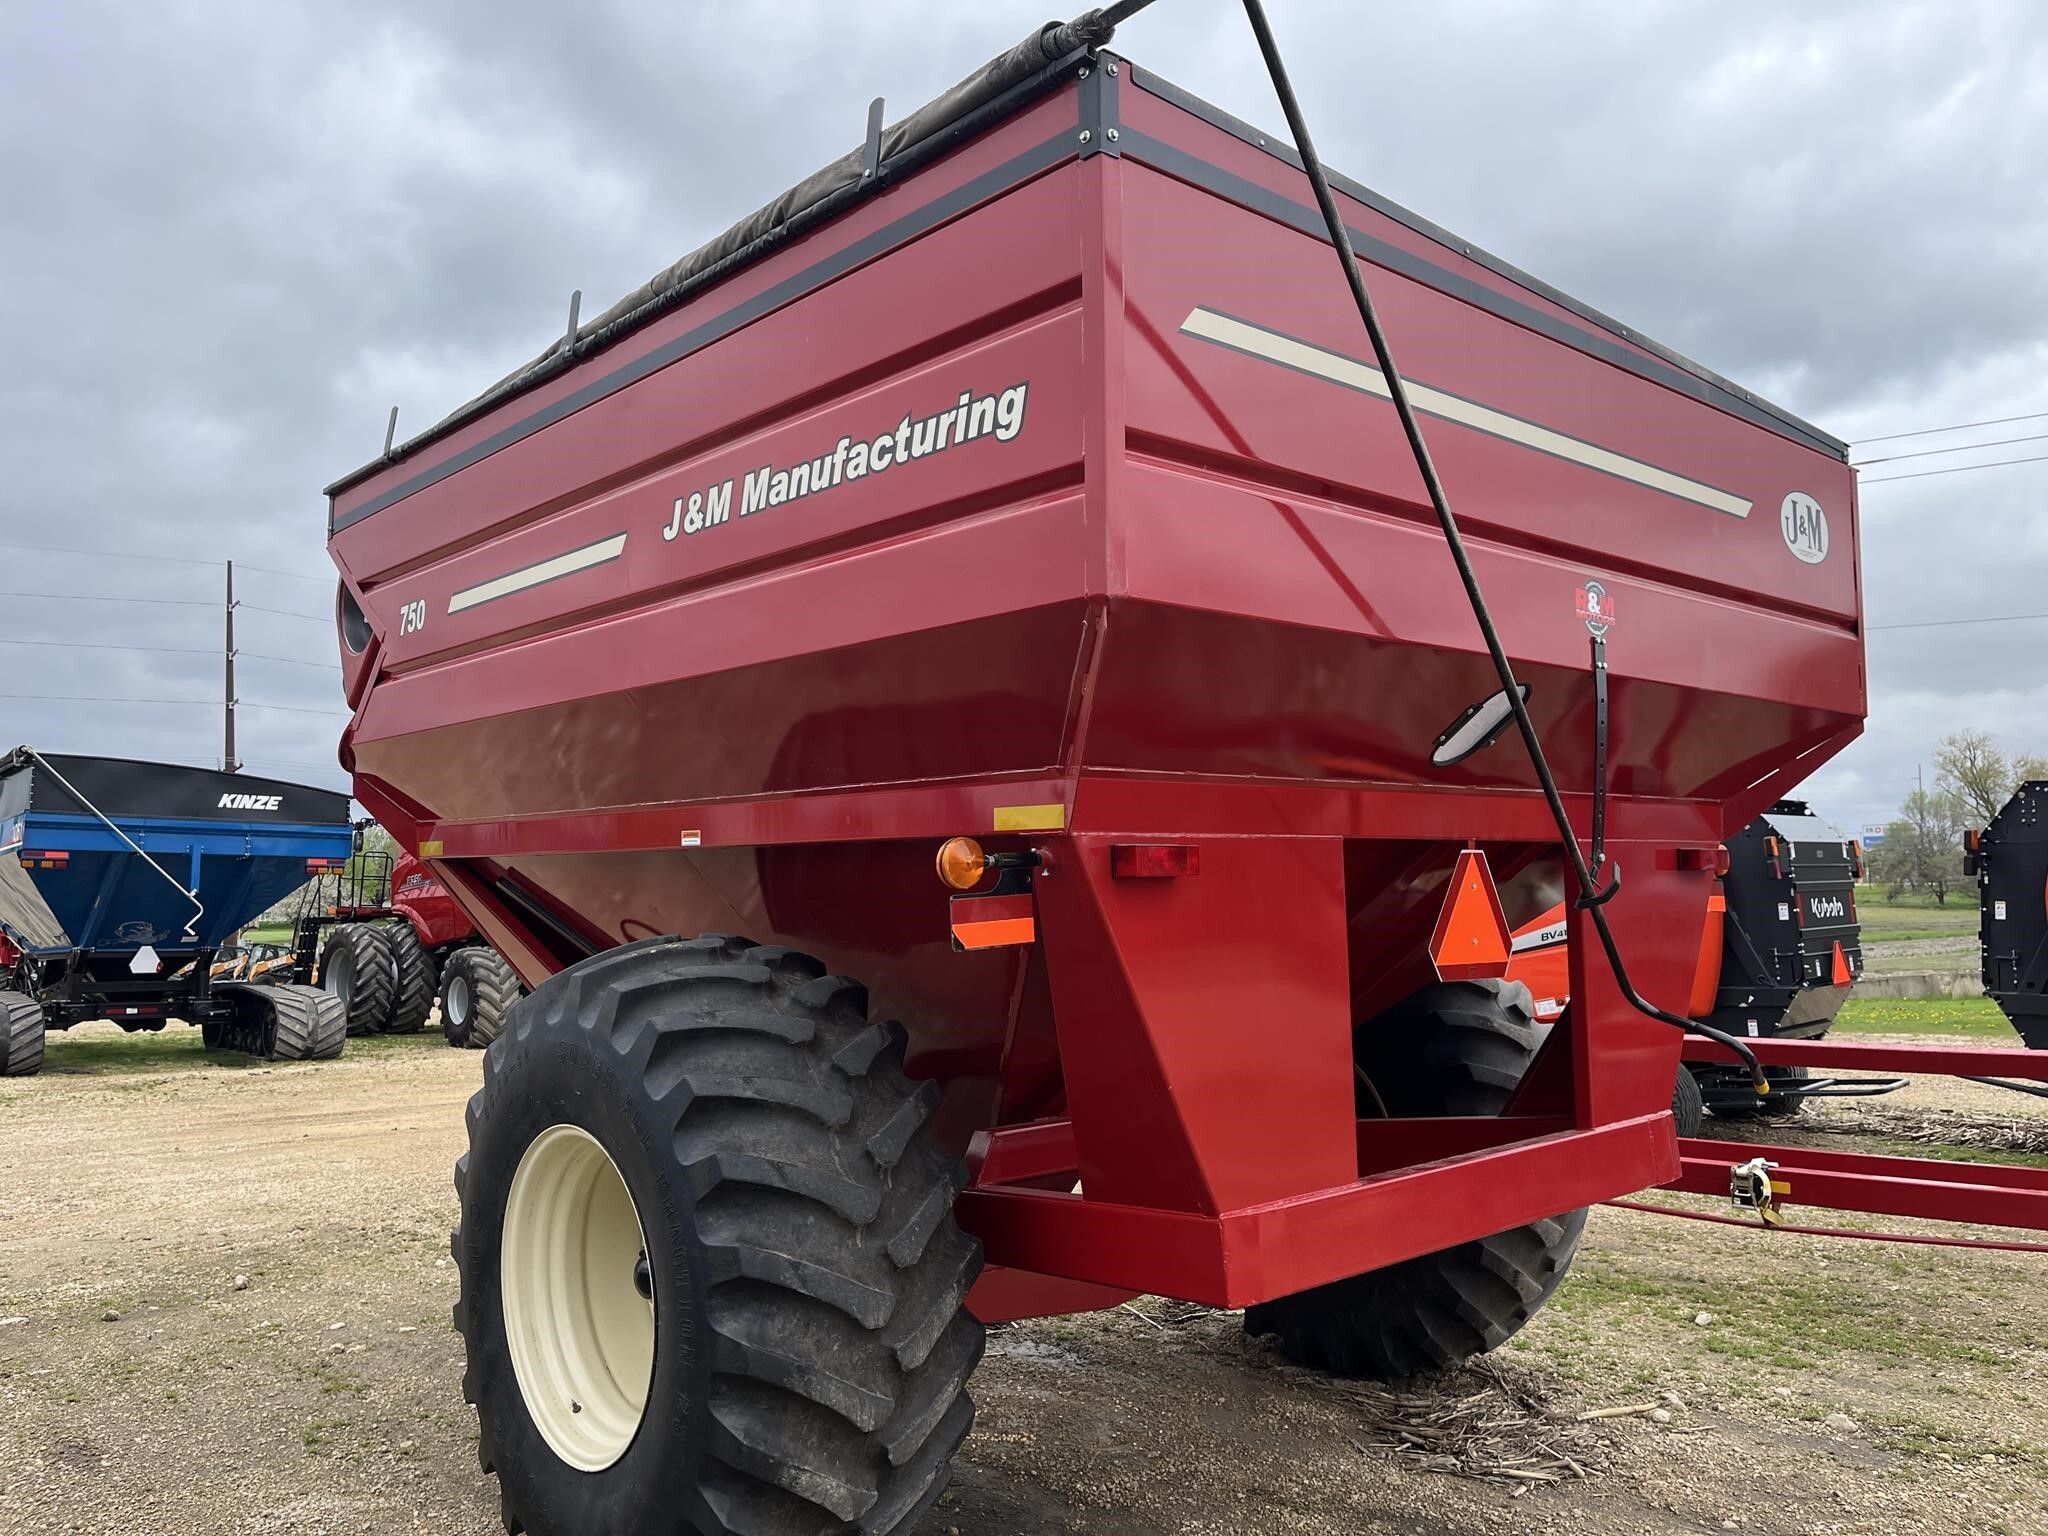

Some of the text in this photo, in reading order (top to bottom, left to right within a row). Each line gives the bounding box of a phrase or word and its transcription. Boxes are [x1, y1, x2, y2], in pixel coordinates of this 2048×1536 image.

[662, 380, 1030, 541] J&M Manufacturing
[1784, 499, 1824, 553] J&M
[400, 599, 426, 637] 750
[217, 793, 283, 811] KINZE
[1811, 896, 1844, 918] Kubota
[557, 1040, 616, 1093] SUPER
[618, 1093, 653, 1154] ALL
[654, 1165, 698, 1369] TRACTION
